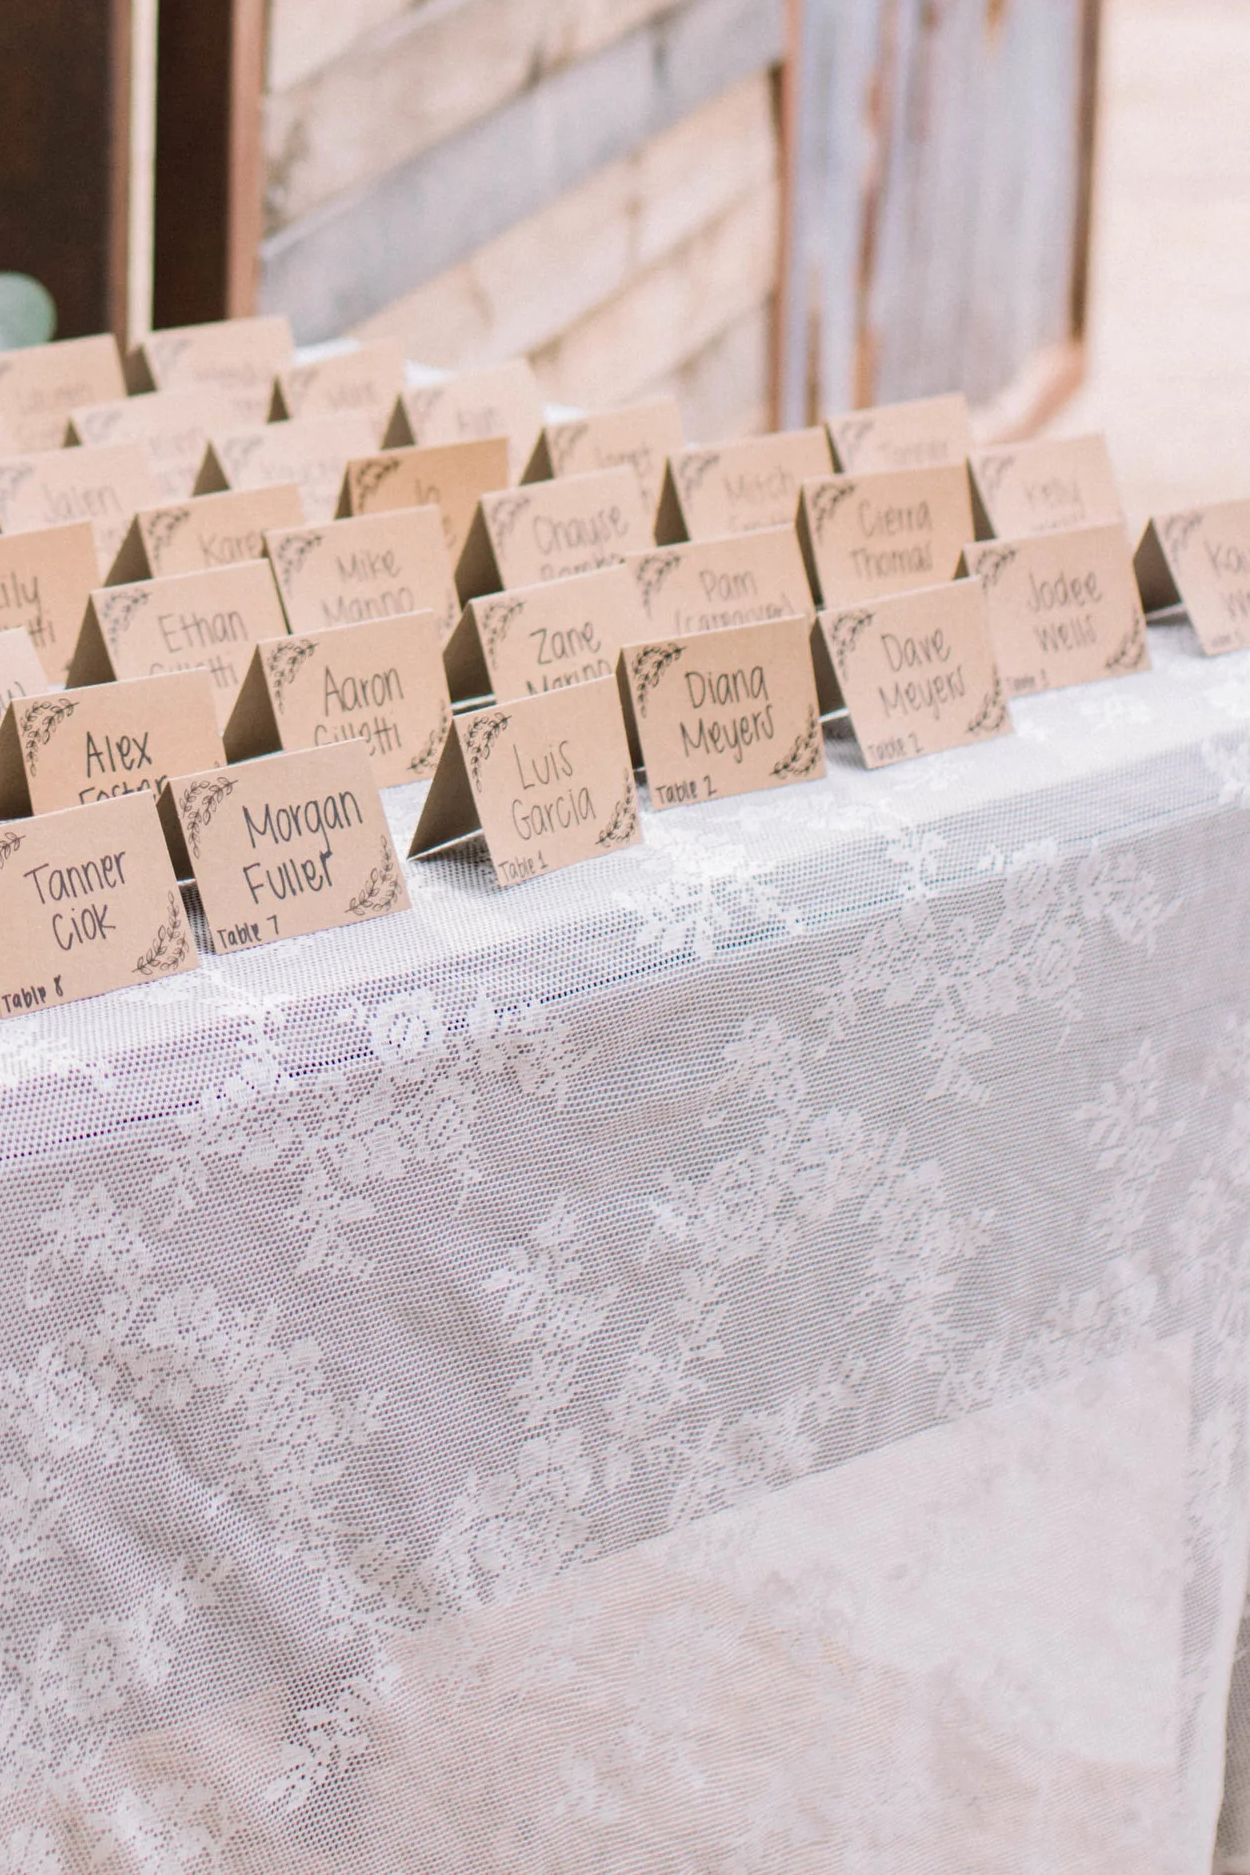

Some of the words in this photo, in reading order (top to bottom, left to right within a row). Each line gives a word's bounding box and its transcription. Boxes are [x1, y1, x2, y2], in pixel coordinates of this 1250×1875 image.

[202, 530, 263, 562] Kare
[335, 548, 402, 584] Mike
[699, 569, 758, 602] Pam
[158, 610, 249, 654] Ethan
[529, 621, 602, 665] Zane
[880, 628, 951, 673] Dave
[323, 665, 405, 719] Aaron
[683, 665, 769, 709] Diana
[85, 730, 153, 779] Alex
[679, 704, 775, 764] Meyers
[512, 739, 574, 791] Luis
[655, 780, 699, 805] Table
[703, 775, 718, 798] 2
[241, 790, 364, 855] Morgan
[511, 785, 597, 841] Garcia
[22, 850, 127, 906] Tanner
[242, 849, 335, 905] Fuller
[498, 856, 535, 882] Table
[216, 921, 262, 951] Table
[265, 913, 281, 937] 7
[1, 984, 47, 1014] Table
[53, 974, 65, 998] 8
